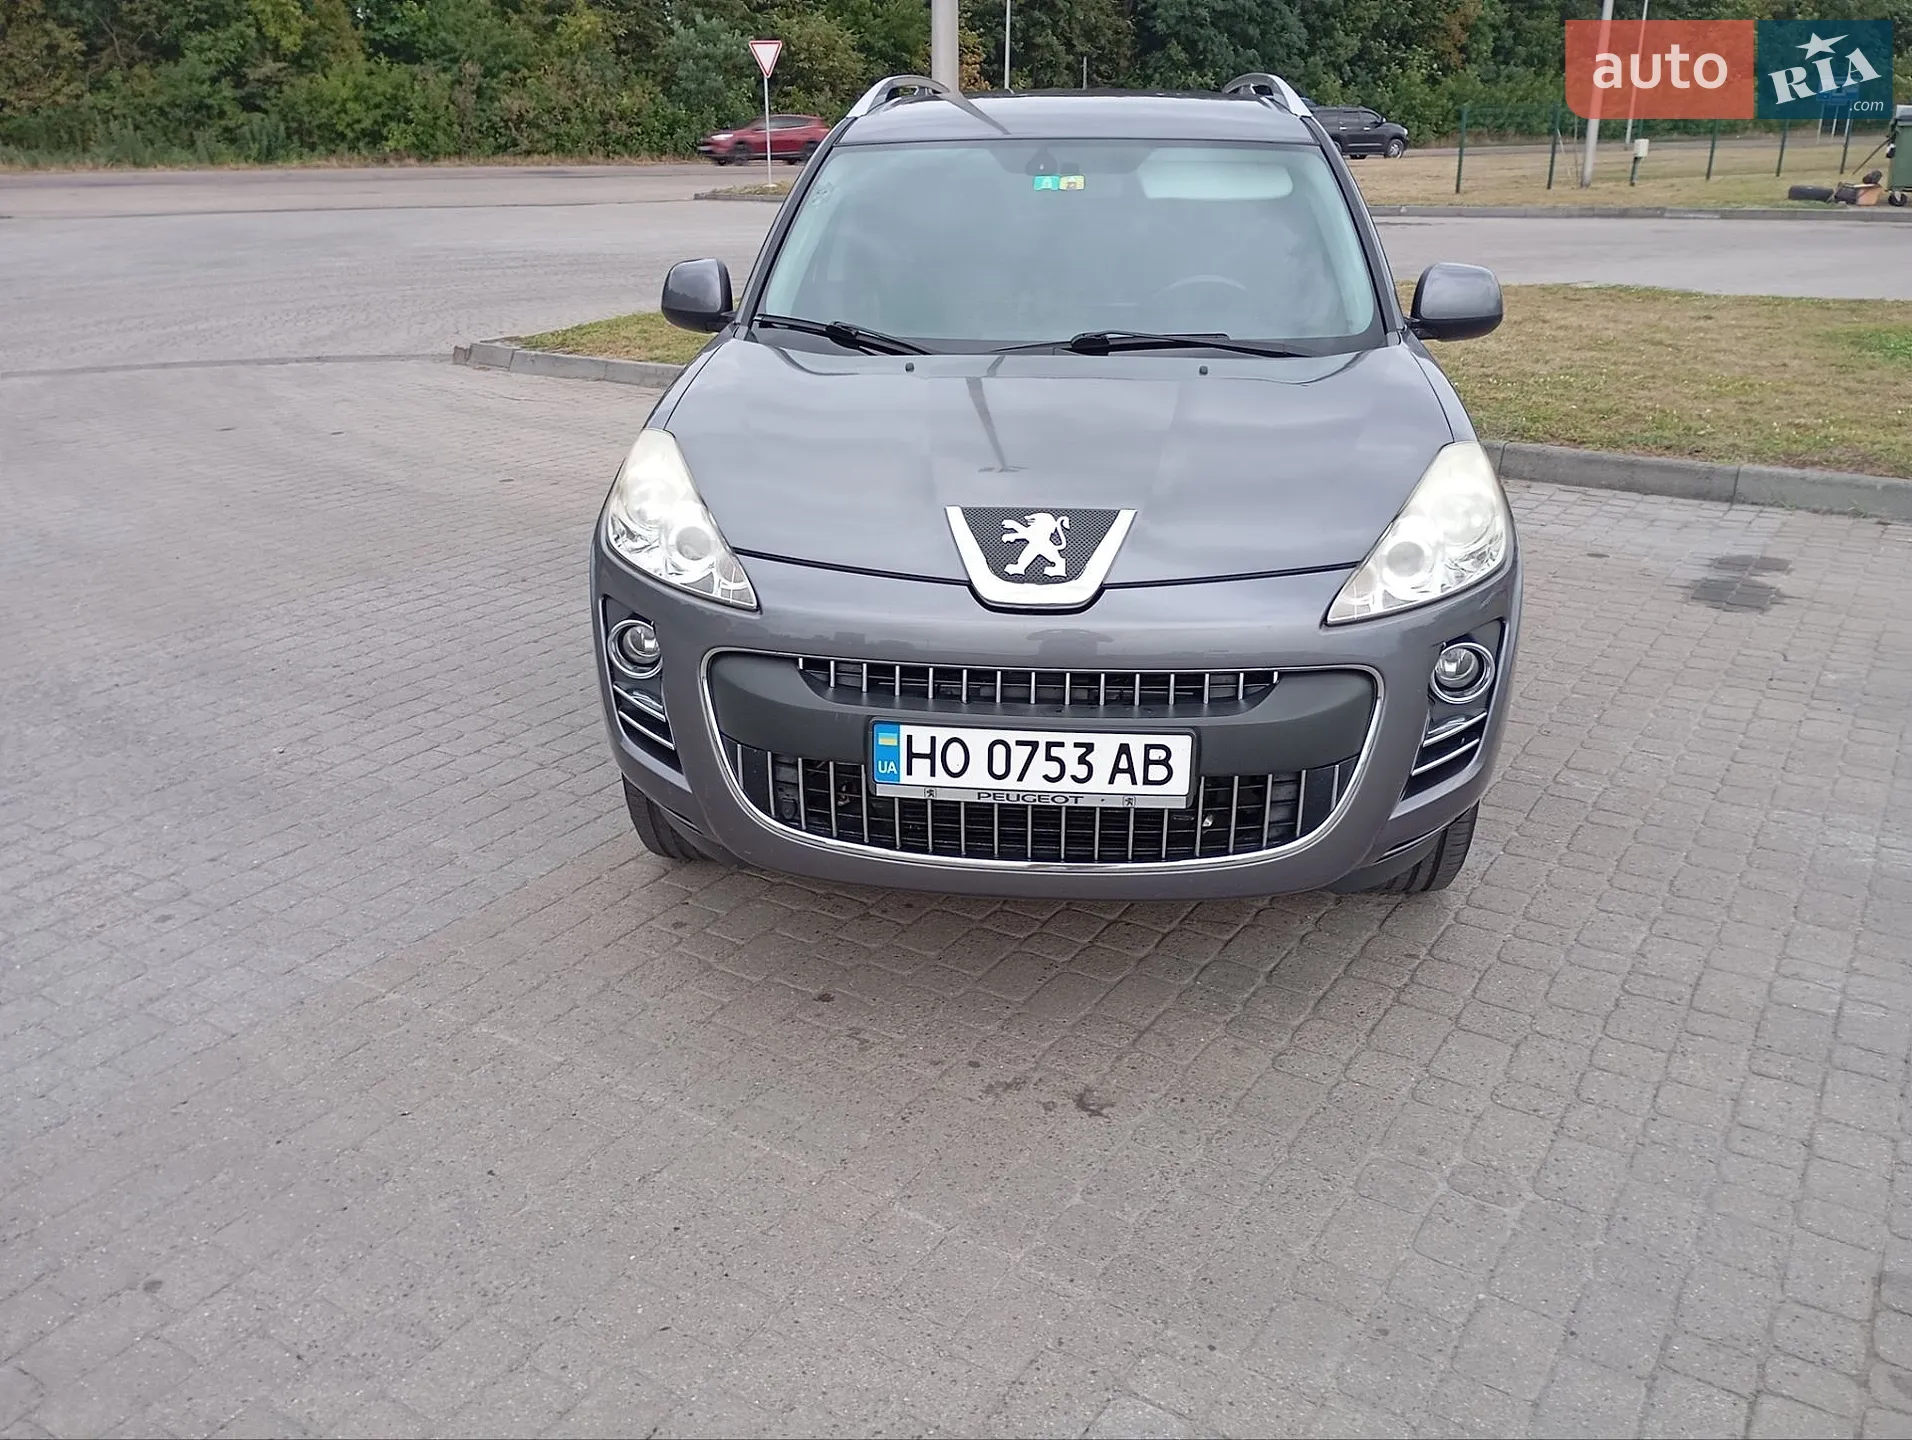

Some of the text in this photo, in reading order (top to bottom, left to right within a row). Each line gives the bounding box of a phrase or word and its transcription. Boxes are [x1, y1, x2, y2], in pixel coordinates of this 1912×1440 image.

[877, 734, 1174, 787] UA HO 0753 AB
[977, 791, 1084, 805] PEUGEOT
